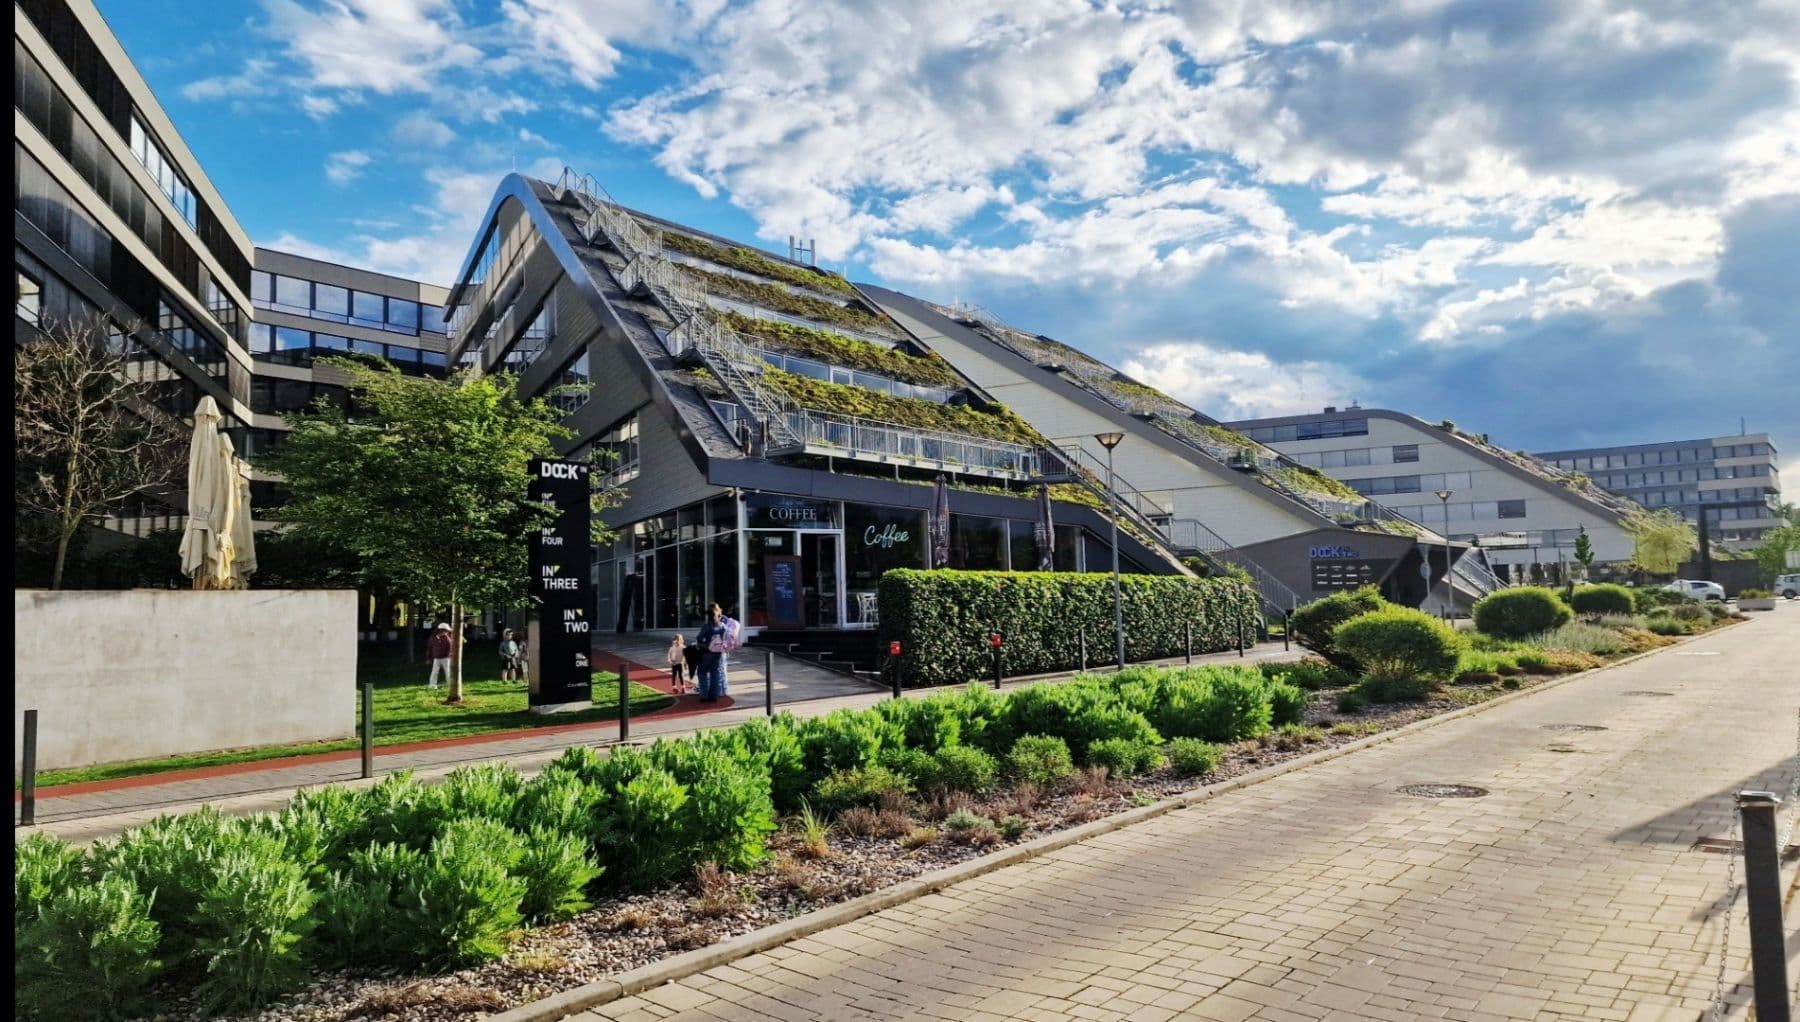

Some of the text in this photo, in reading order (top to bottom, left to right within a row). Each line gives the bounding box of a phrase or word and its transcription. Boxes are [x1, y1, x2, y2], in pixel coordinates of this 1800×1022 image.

[541, 461, 579, 480] DOCK
[769, 507, 817, 520] COFFEE
[542, 527, 551, 536] IN
[864, 524, 909, 548] Coffee
[542, 536, 563, 546] FOUR
[542, 565, 554, 577] IN
[542, 577, 579, 590] THREE
[563, 609, 576, 621] IN
[564, 621, 589, 633] TWO
